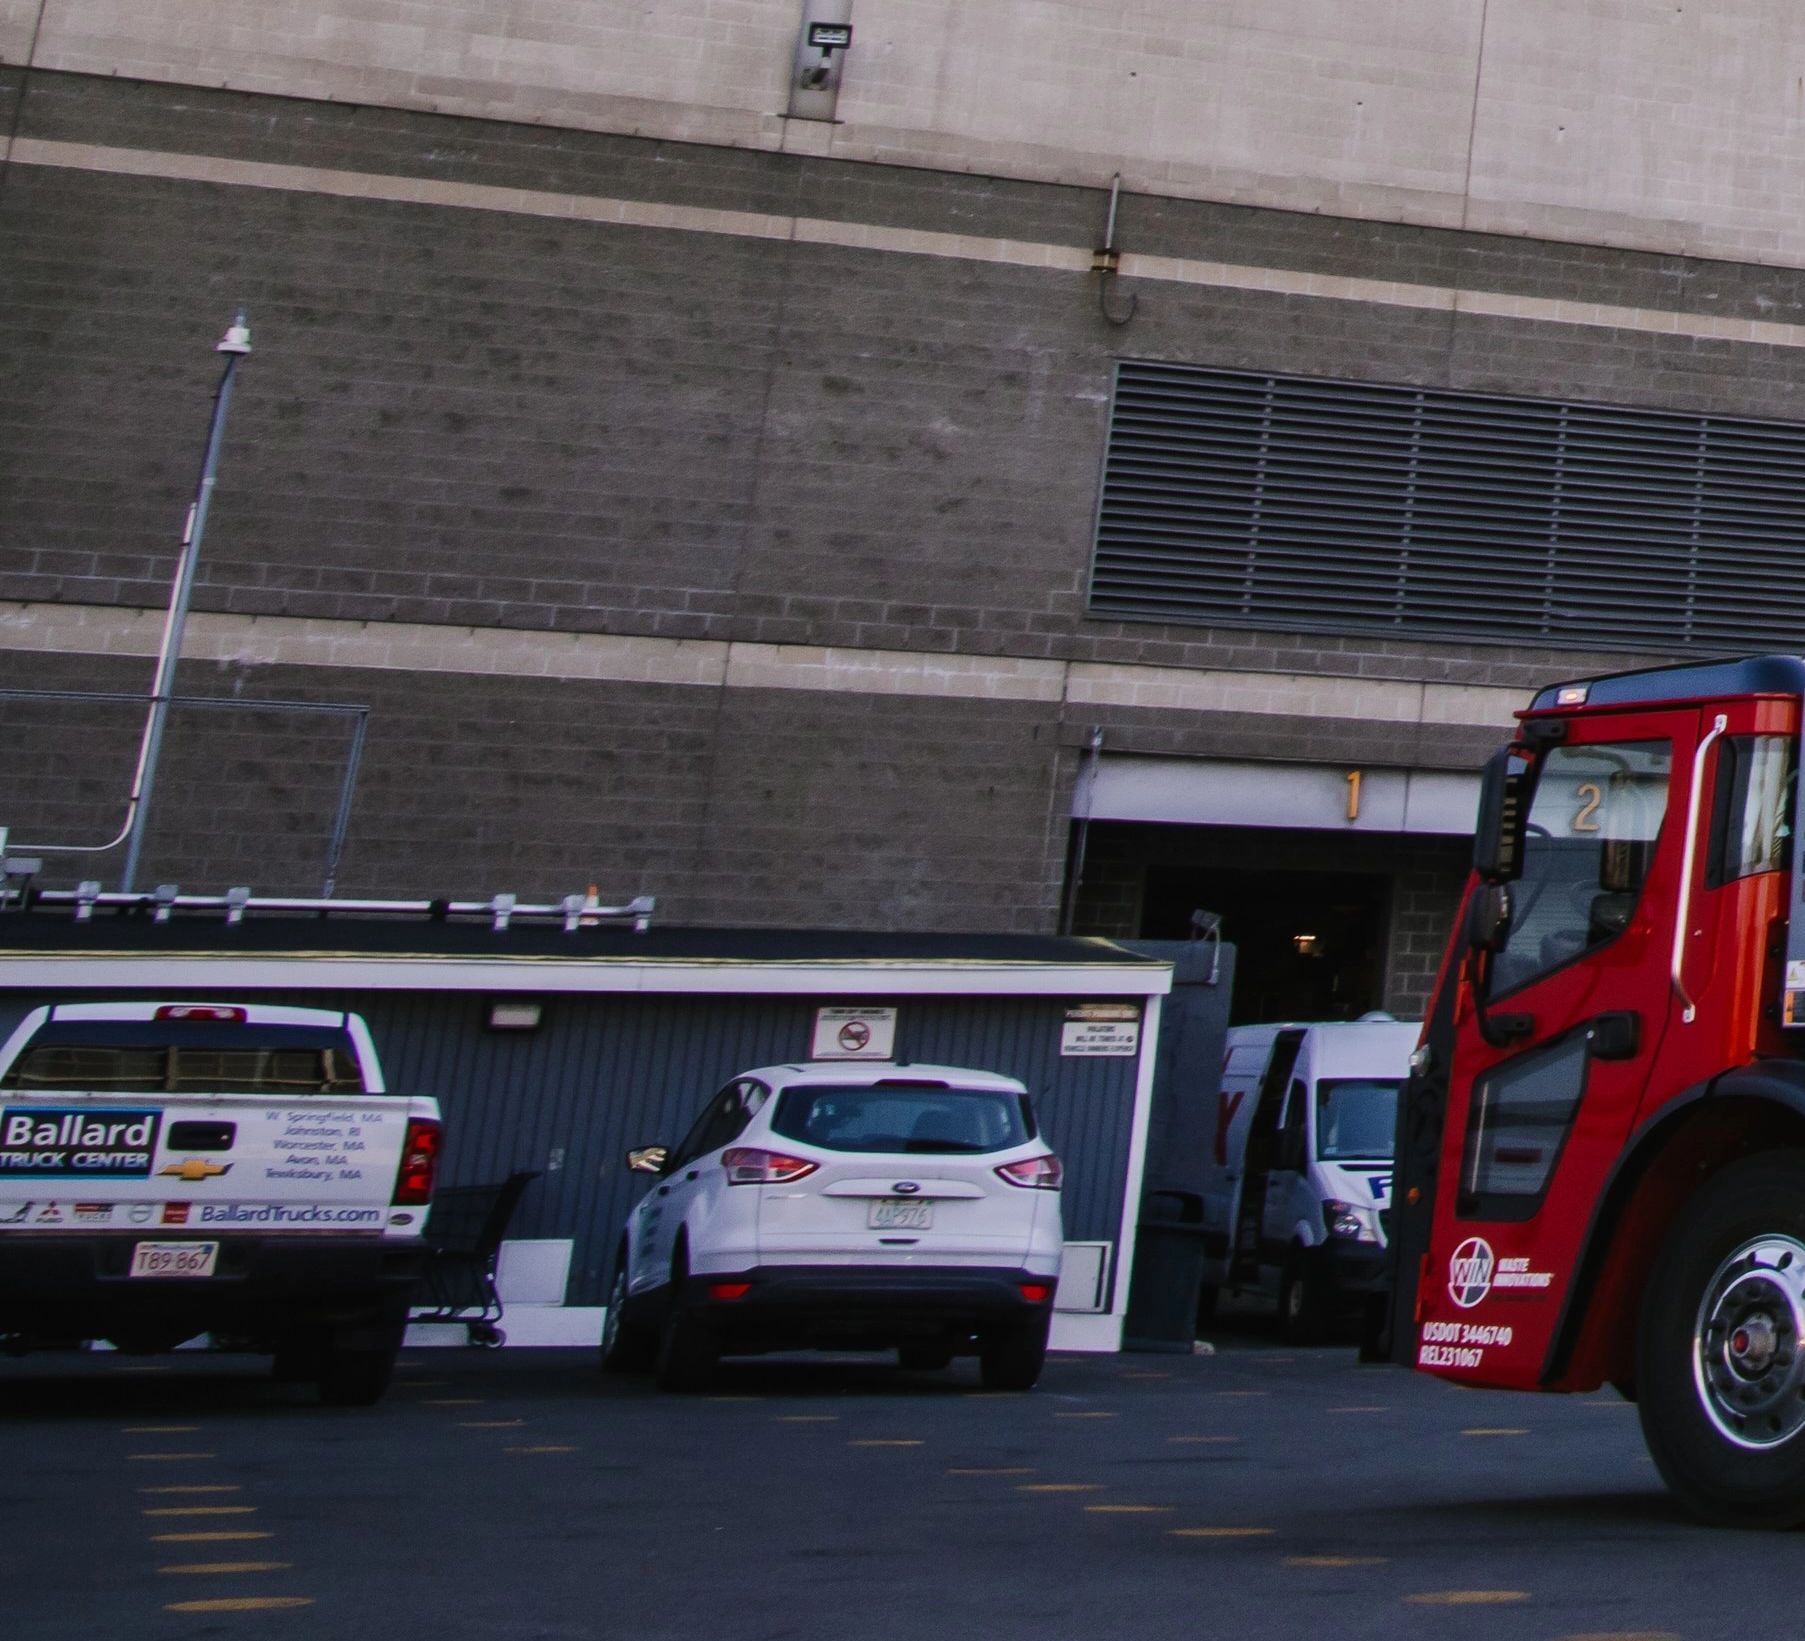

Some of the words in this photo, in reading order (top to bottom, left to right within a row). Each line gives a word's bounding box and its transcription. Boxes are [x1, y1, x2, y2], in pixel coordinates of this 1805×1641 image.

[1346, 770, 1361, 820] 1
[1572, 783, 1601, 832] 2
[362, 1113, 384, 1122] MA
[4, 1114, 155, 1147] Ballard
[343, 1141, 366, 1151] MA
[0, 1152, 68, 1168] TRUCK
[71, 1152, 150, 1168] CENTER
[325, 1155, 349, 1165] MA
[338, 1169, 363, 1180] MA
[200, 1204, 381, 1223] BallardTrucks.com
[138, 1251, 171, 1270] T89
[176, 1250, 213, 1270] 867
[1498, 1257, 1531, 1272] WASTE
[1422, 1321, 1462, 1342] USDOT
[1460, 1324, 1513, 1346] 3446740
